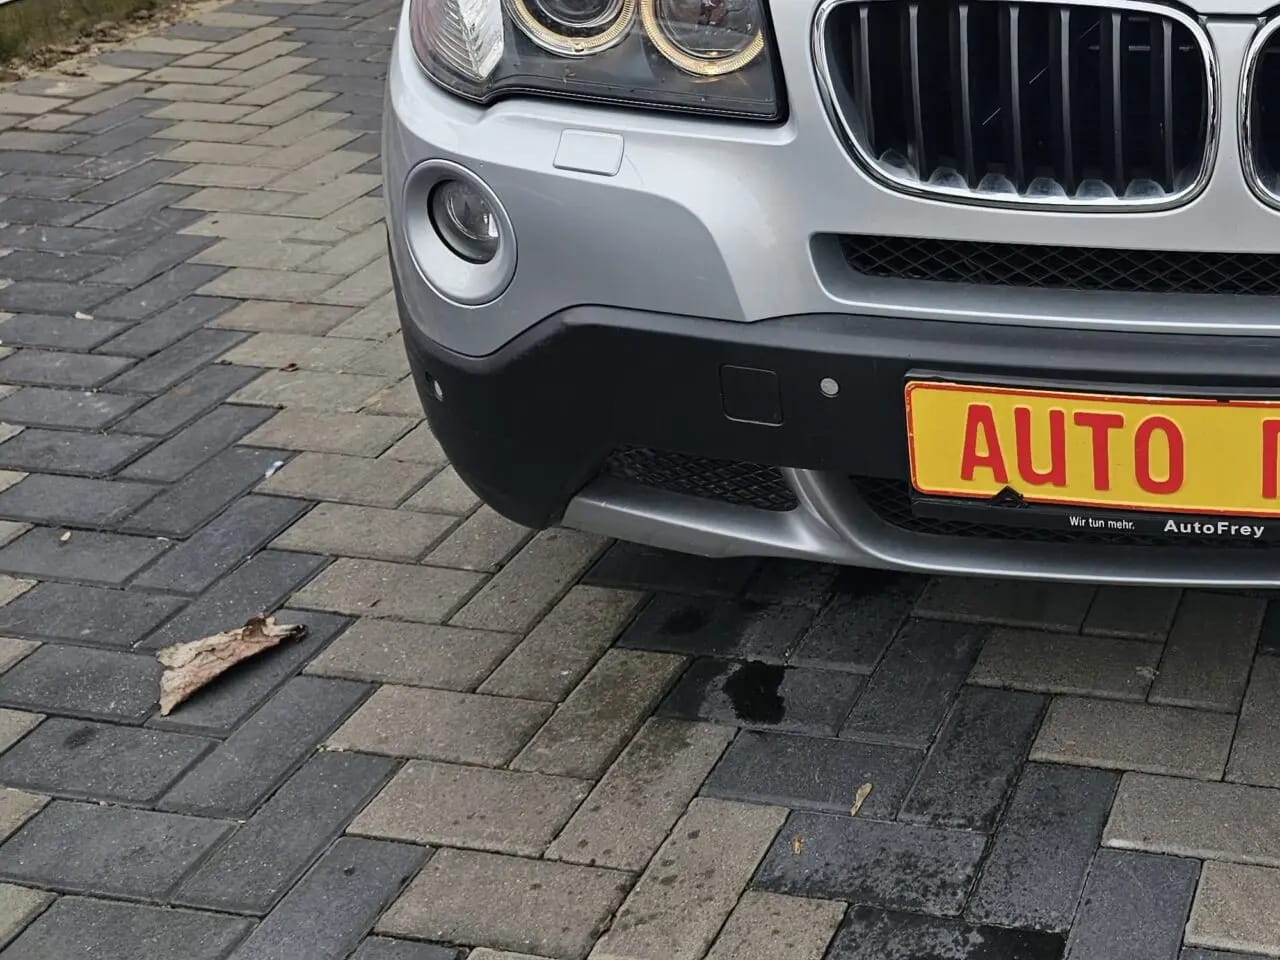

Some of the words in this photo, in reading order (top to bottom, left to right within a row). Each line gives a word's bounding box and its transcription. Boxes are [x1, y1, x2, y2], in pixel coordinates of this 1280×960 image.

[961, 404, 1185, 494] AUTO
[1069, 515, 1086, 527] Wir
[1088, 517, 1105, 529] tun
[1108, 518, 1135, 531] mehr.
[1163, 519, 1265, 538] AutoFrey
